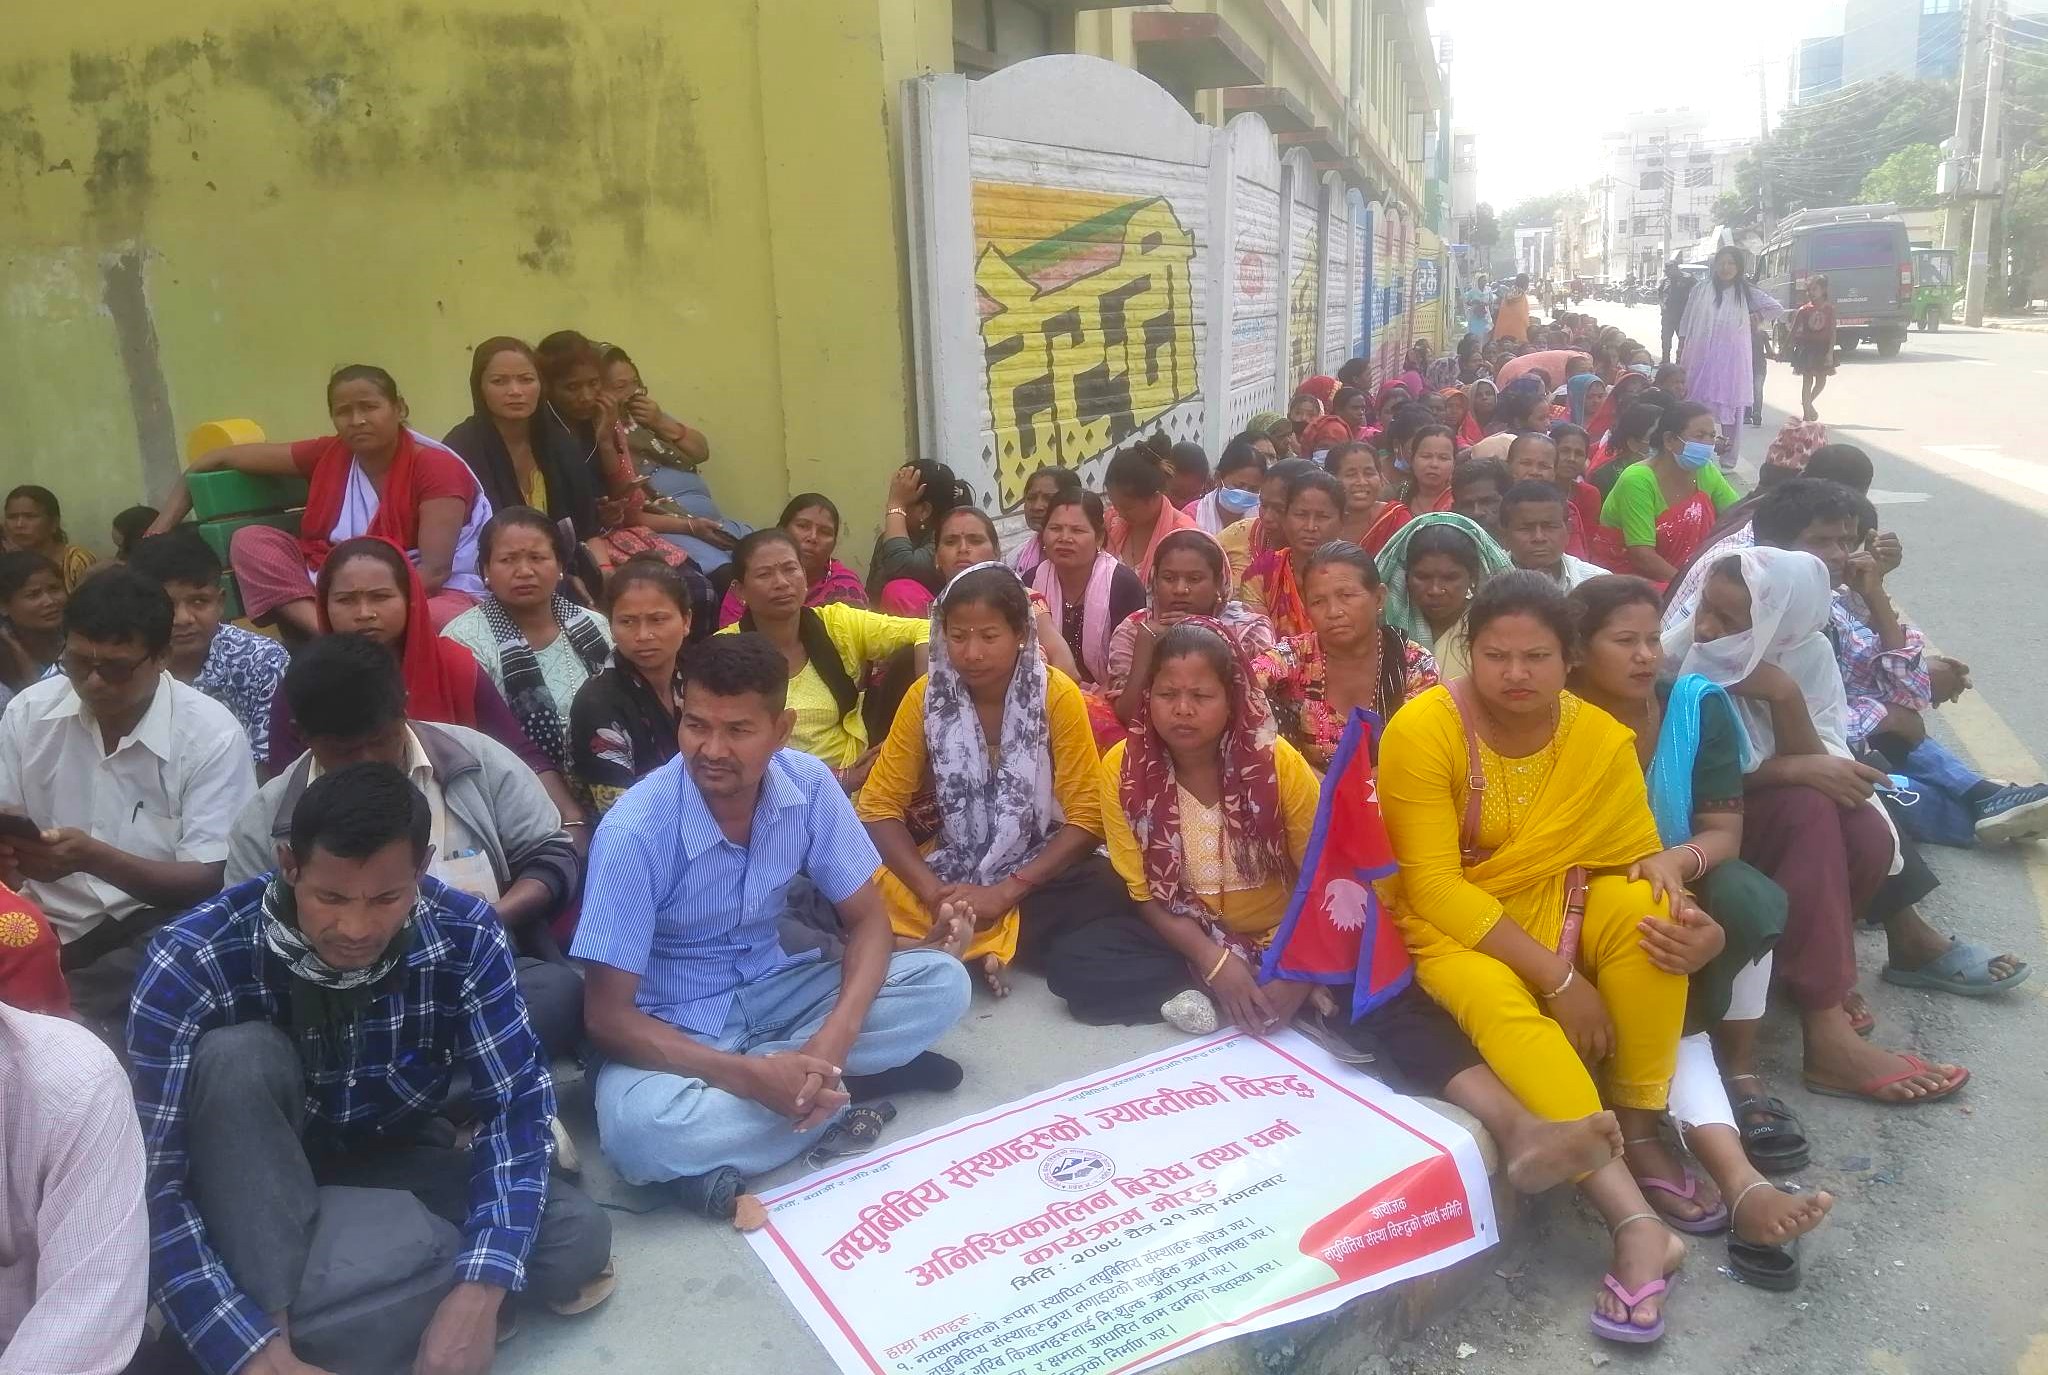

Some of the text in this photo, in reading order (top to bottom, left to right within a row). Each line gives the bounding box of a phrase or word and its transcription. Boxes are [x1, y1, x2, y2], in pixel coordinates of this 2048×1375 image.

[1084, 1080, 1231, 1130] ज्यादतीको
[1111, 1162, 1195, 1199] बिरोध
[1190, 1142, 1249, 1170] तथा
[1244, 1118, 1302, 1147] धर्ना
[1365, 1228, 1389, 1247] संस्था
[1440, 1199, 1463, 1221] समिति
[1369, 1196, 1407, 1220] आयोजक
[1010, 1265, 1056, 1291] मिति
[1160, 1213, 1186, 1227] २१
[1019, 1207, 1144, 1265] कार्यक्रम
[1038, 1283, 1087, 1310] स्थापित
[1087, 1321, 1141, 1349] आधारित
[1140, 1307, 1169, 1325] काम
